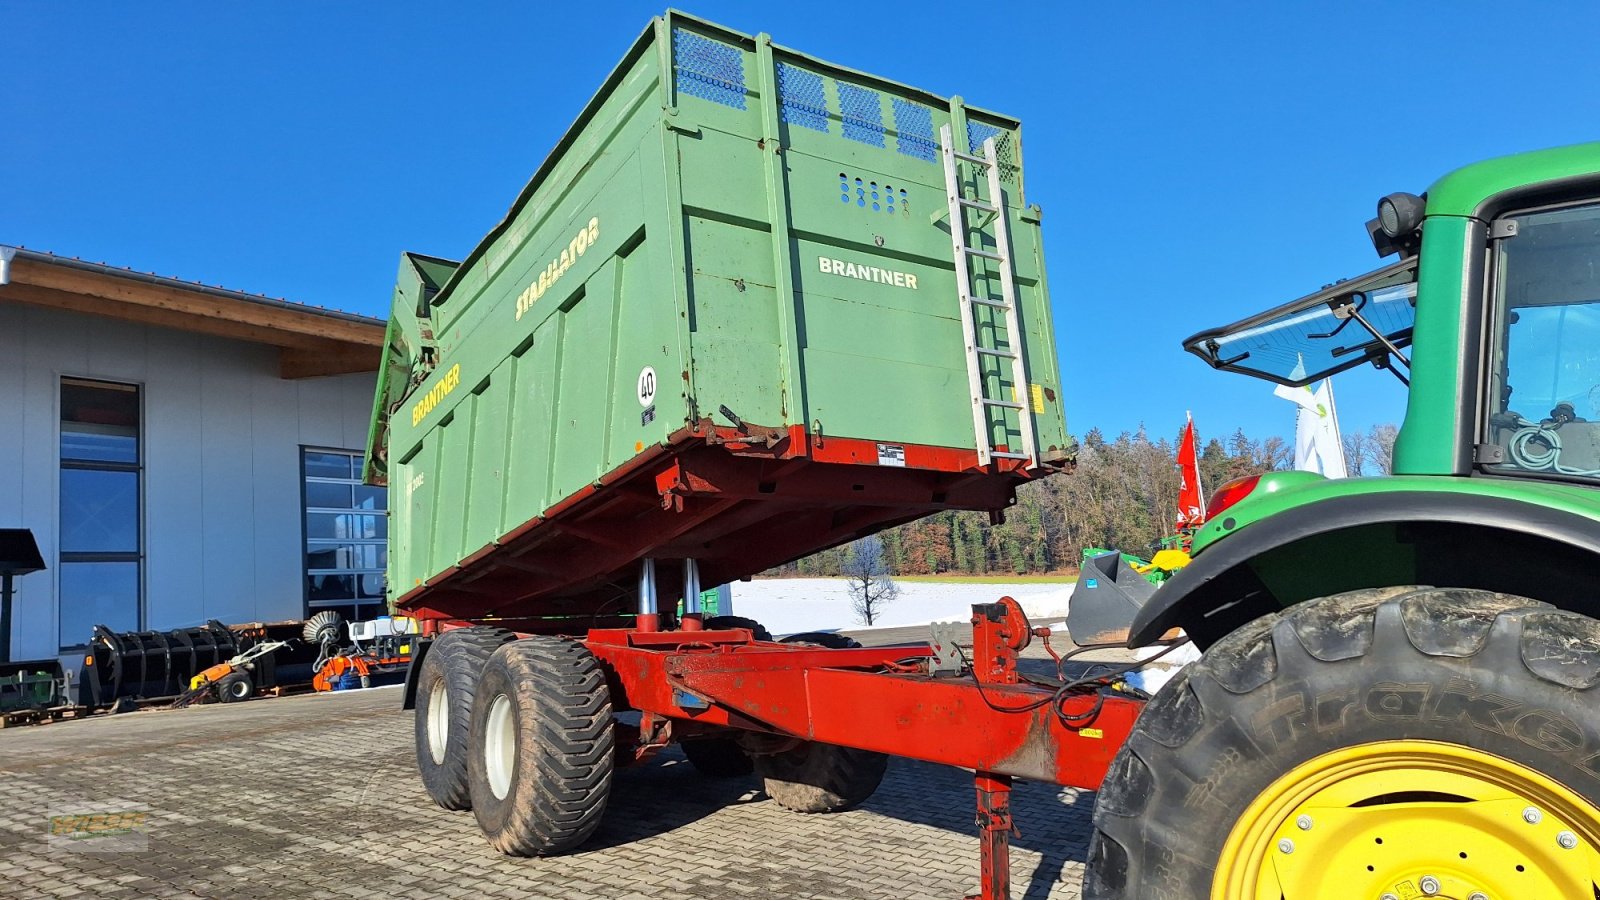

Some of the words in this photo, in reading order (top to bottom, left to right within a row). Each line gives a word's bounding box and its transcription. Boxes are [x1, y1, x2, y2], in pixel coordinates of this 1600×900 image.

[515, 216, 599, 321] STABILATOR
[818, 256, 918, 290] BRANTNER
[412, 363, 460, 427] BRANTNER
[641, 371, 653, 399] 40
